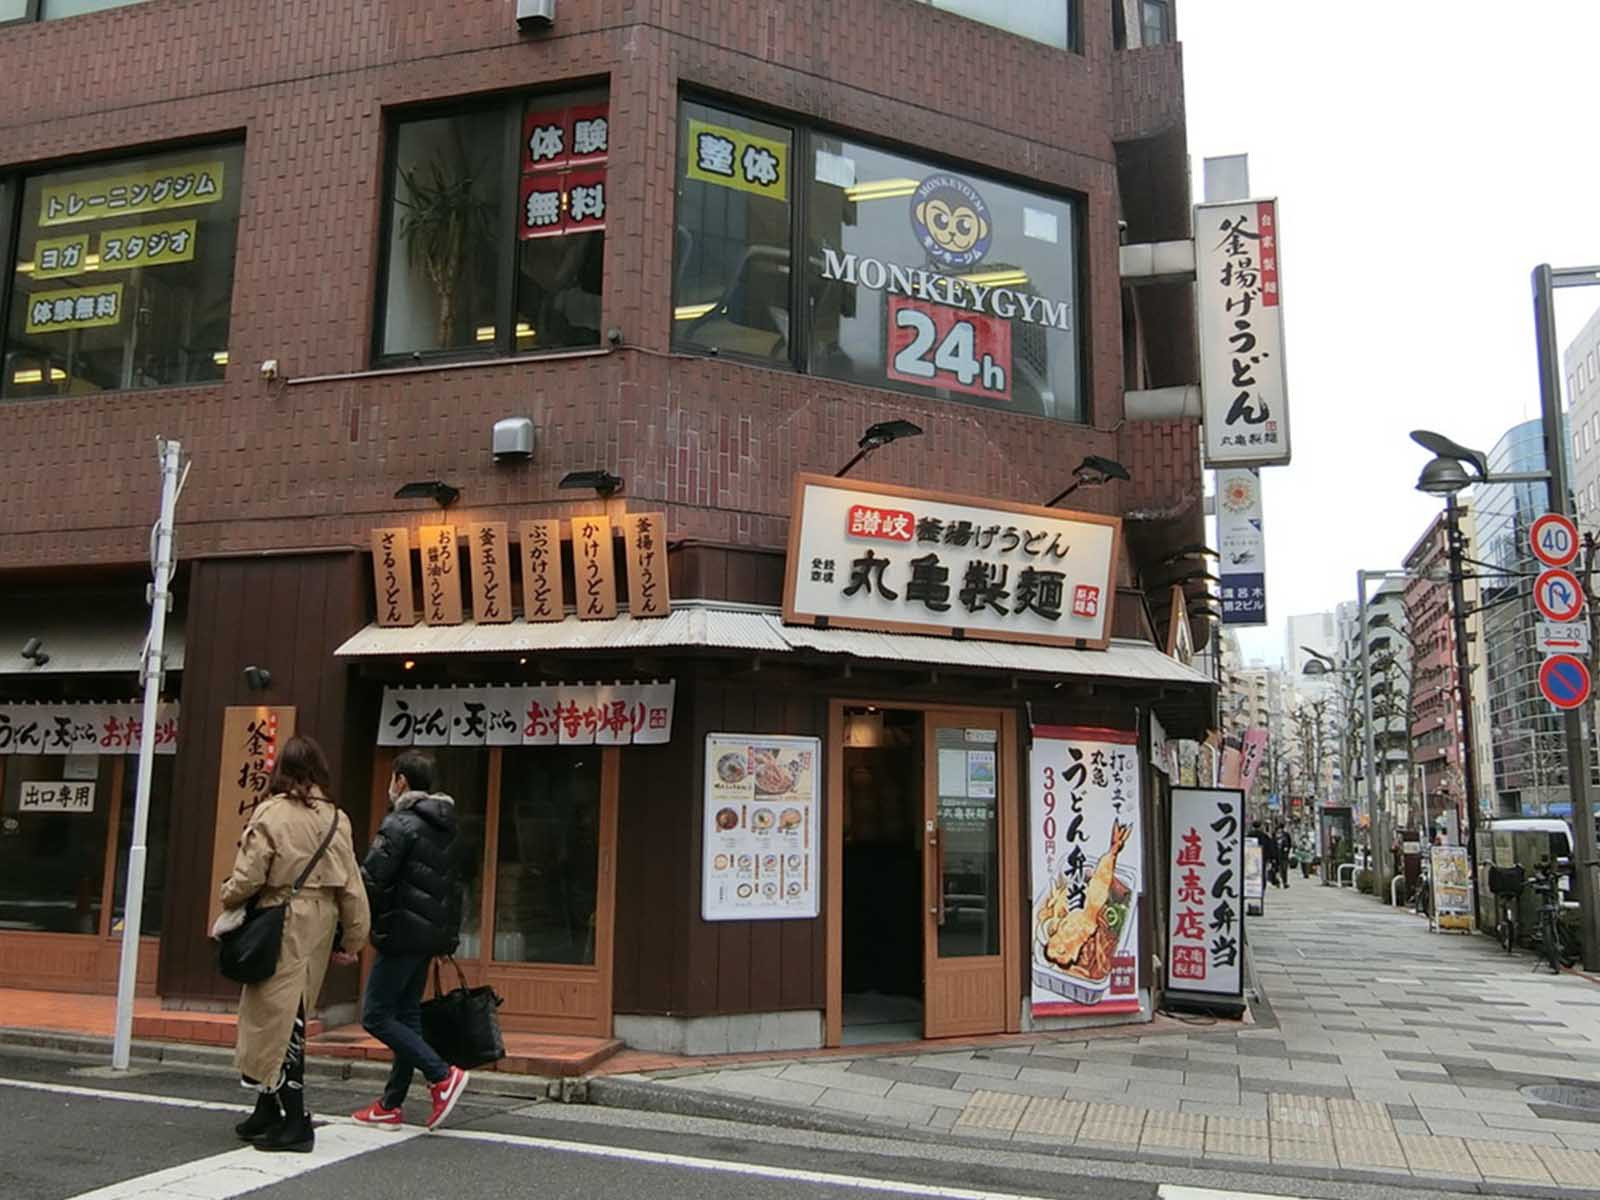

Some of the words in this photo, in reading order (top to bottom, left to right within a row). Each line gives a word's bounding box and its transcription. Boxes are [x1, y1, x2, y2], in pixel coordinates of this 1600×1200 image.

[528, 117, 608, 162] 体験
[697, 132, 779, 187] 整体
[48, 174, 215, 218] トレーニングジム
[526, 183, 605, 227] 無料
[919, 177, 985, 212] MONKEYGYM
[41, 245, 82, 270] ヨガ
[103, 231, 189, 261] スタジオ
[31, 293, 118, 326] 体験無料
[821, 247, 1071, 331] MONKEYGYM
[1215, 214, 1270, 426] 釜揚げうどん
[893, 307, 1007, 392] 24h
[439, 529, 453, 575] おろし
[915, 515, 1070, 559] 釜揚げうどん
[1542, 529, 1569, 551] 40
[479, 527, 500, 618] 釜玉うどん
[529, 524, 551, 617] ぶっかけうどん
[581, 522, 604, 615] かけうどん
[635, 516, 657, 613] 釜揚げうどん
[842, 549, 1067, 622] 丸亀製麺
[523, 699, 647, 740] お持ち帰り
[1091, 750, 1109, 788] 丸亀
[1110, 750, 1126, 814] 打ち立て
[23, 784, 91, 808] 出口専用
[1062, 747, 1090, 912] うどん弁当
[1173, 827, 1207, 941] 直売店
[1209, 803, 1239, 968] うどん弁当
